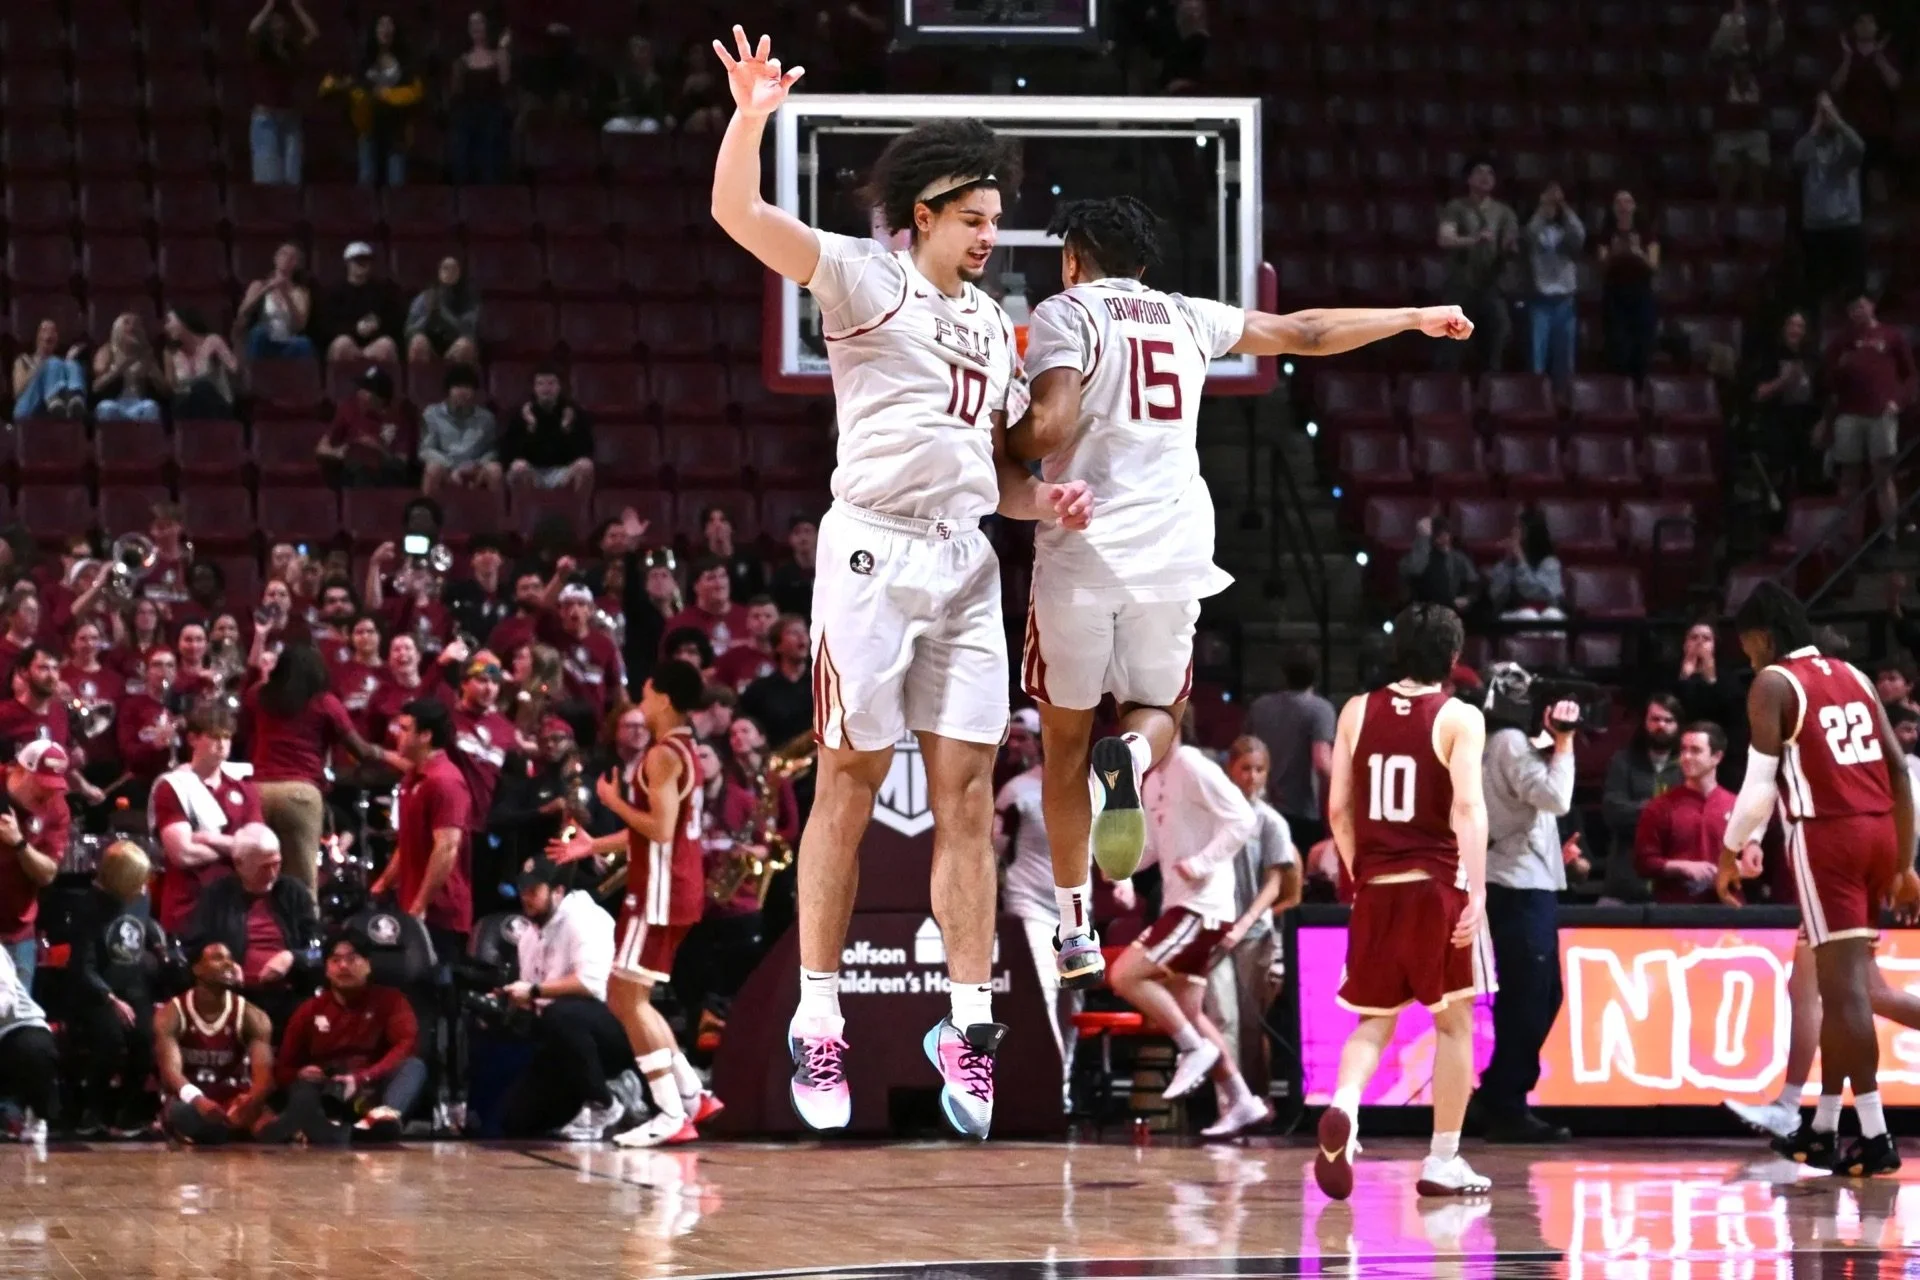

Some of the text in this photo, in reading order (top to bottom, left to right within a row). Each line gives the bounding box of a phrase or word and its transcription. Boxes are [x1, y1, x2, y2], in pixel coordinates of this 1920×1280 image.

[1103, 297, 1171, 325] CRAWFORD
[934, 317, 991, 361] FSU
[945, 363, 988, 427] 10
[1126, 336, 1183, 421] 15
[935, 521, 952, 540] FSU
[1818, 701, 1883, 765] 22
[1367, 753, 1417, 823] 10
[841, 940, 907, 964] olfson
[924, 970, 1011, 993] Hoal
